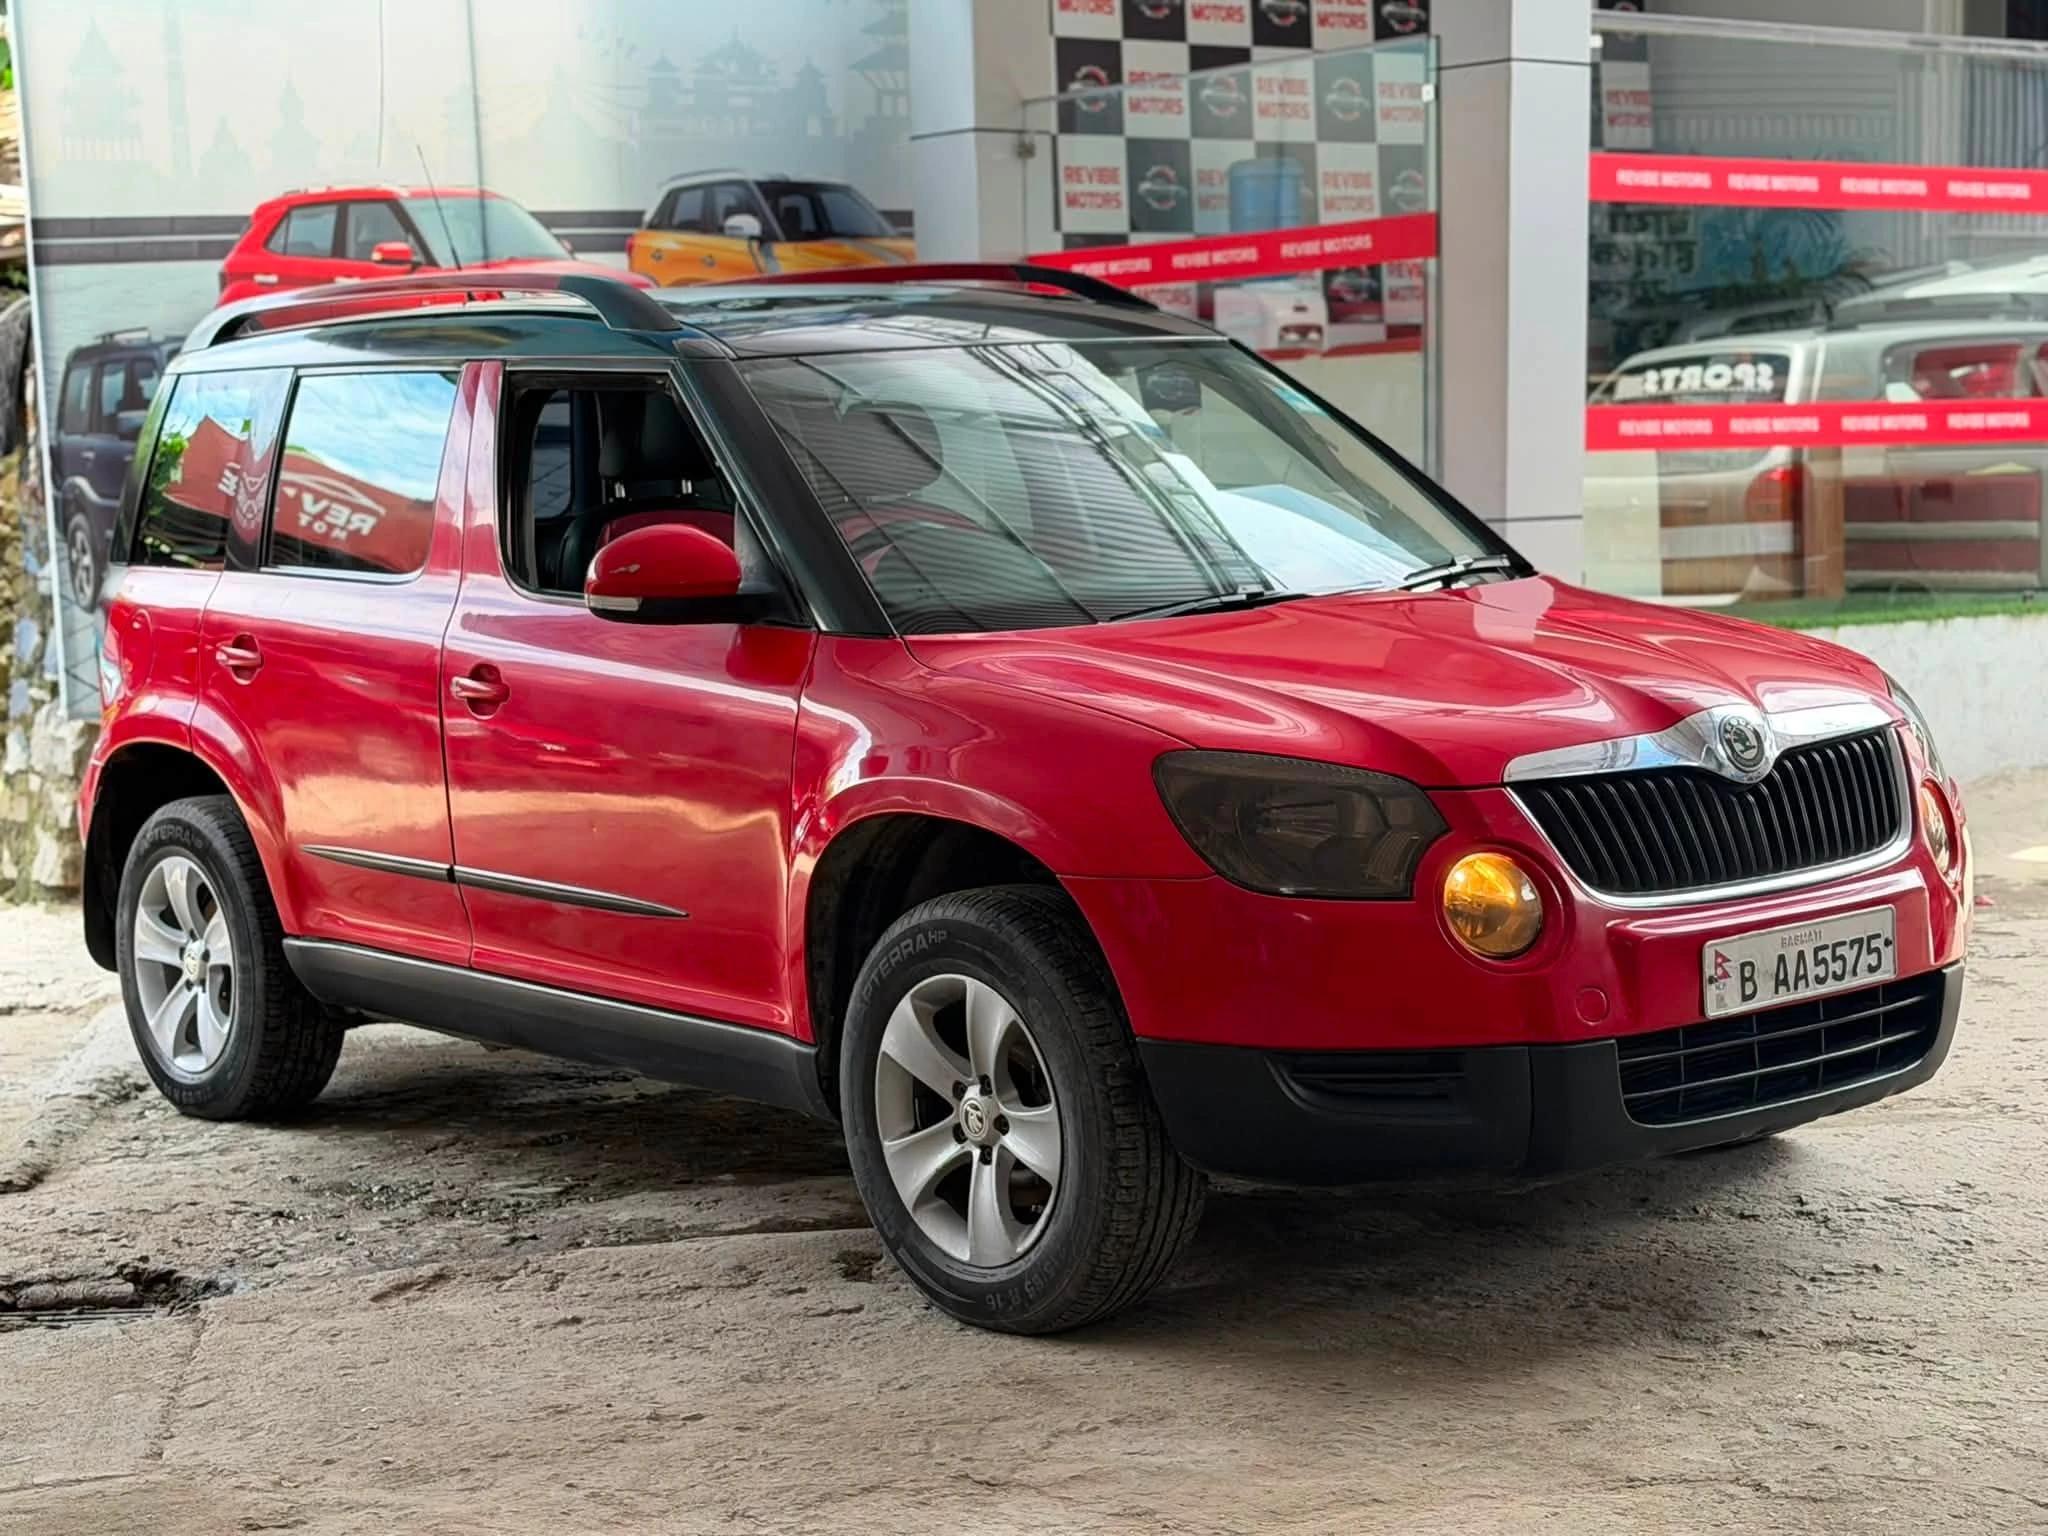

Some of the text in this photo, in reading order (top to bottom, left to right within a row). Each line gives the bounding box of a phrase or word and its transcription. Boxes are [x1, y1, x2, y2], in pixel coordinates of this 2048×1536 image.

[1059, 0, 1114, 16] MOTORS
[1191, 4, 1245, 24] MOTORS
[1316, 11, 1368, 30] MOTORS
[1128, 96, 1184, 114] MOTORS
[1258, 102, 1311, 120] MOTORS
[1063, 165, 1121, 185] REVIBE
[1616, 168, 1712, 190] REVIBE MOTORS
[1728, 173, 1820, 193] REVIBE MOTORS
[1840, 176, 1928, 197] REVIBE MOTORS
[1947, 180, 2031, 200] REVIBE MOTORS
[1065, 192, 1122, 210] MOTORS
[1280, 234, 1373, 259] REVIBE MOTORS
[1108, 257, 1152, 275] MOTORS
[1172, 247, 1258, 269] REVIBE MOTORS
[1618, 418, 1713, 437] REVIBE MOTORS
[1729, 416, 1820, 434] REVIBE MOTORS
[1840, 413, 1928, 432] REVIBE MOTORS
[1946, 411, 2030, 429] REVIBE MOTORS
[1739, 932, 1882, 1003] B AA5575
